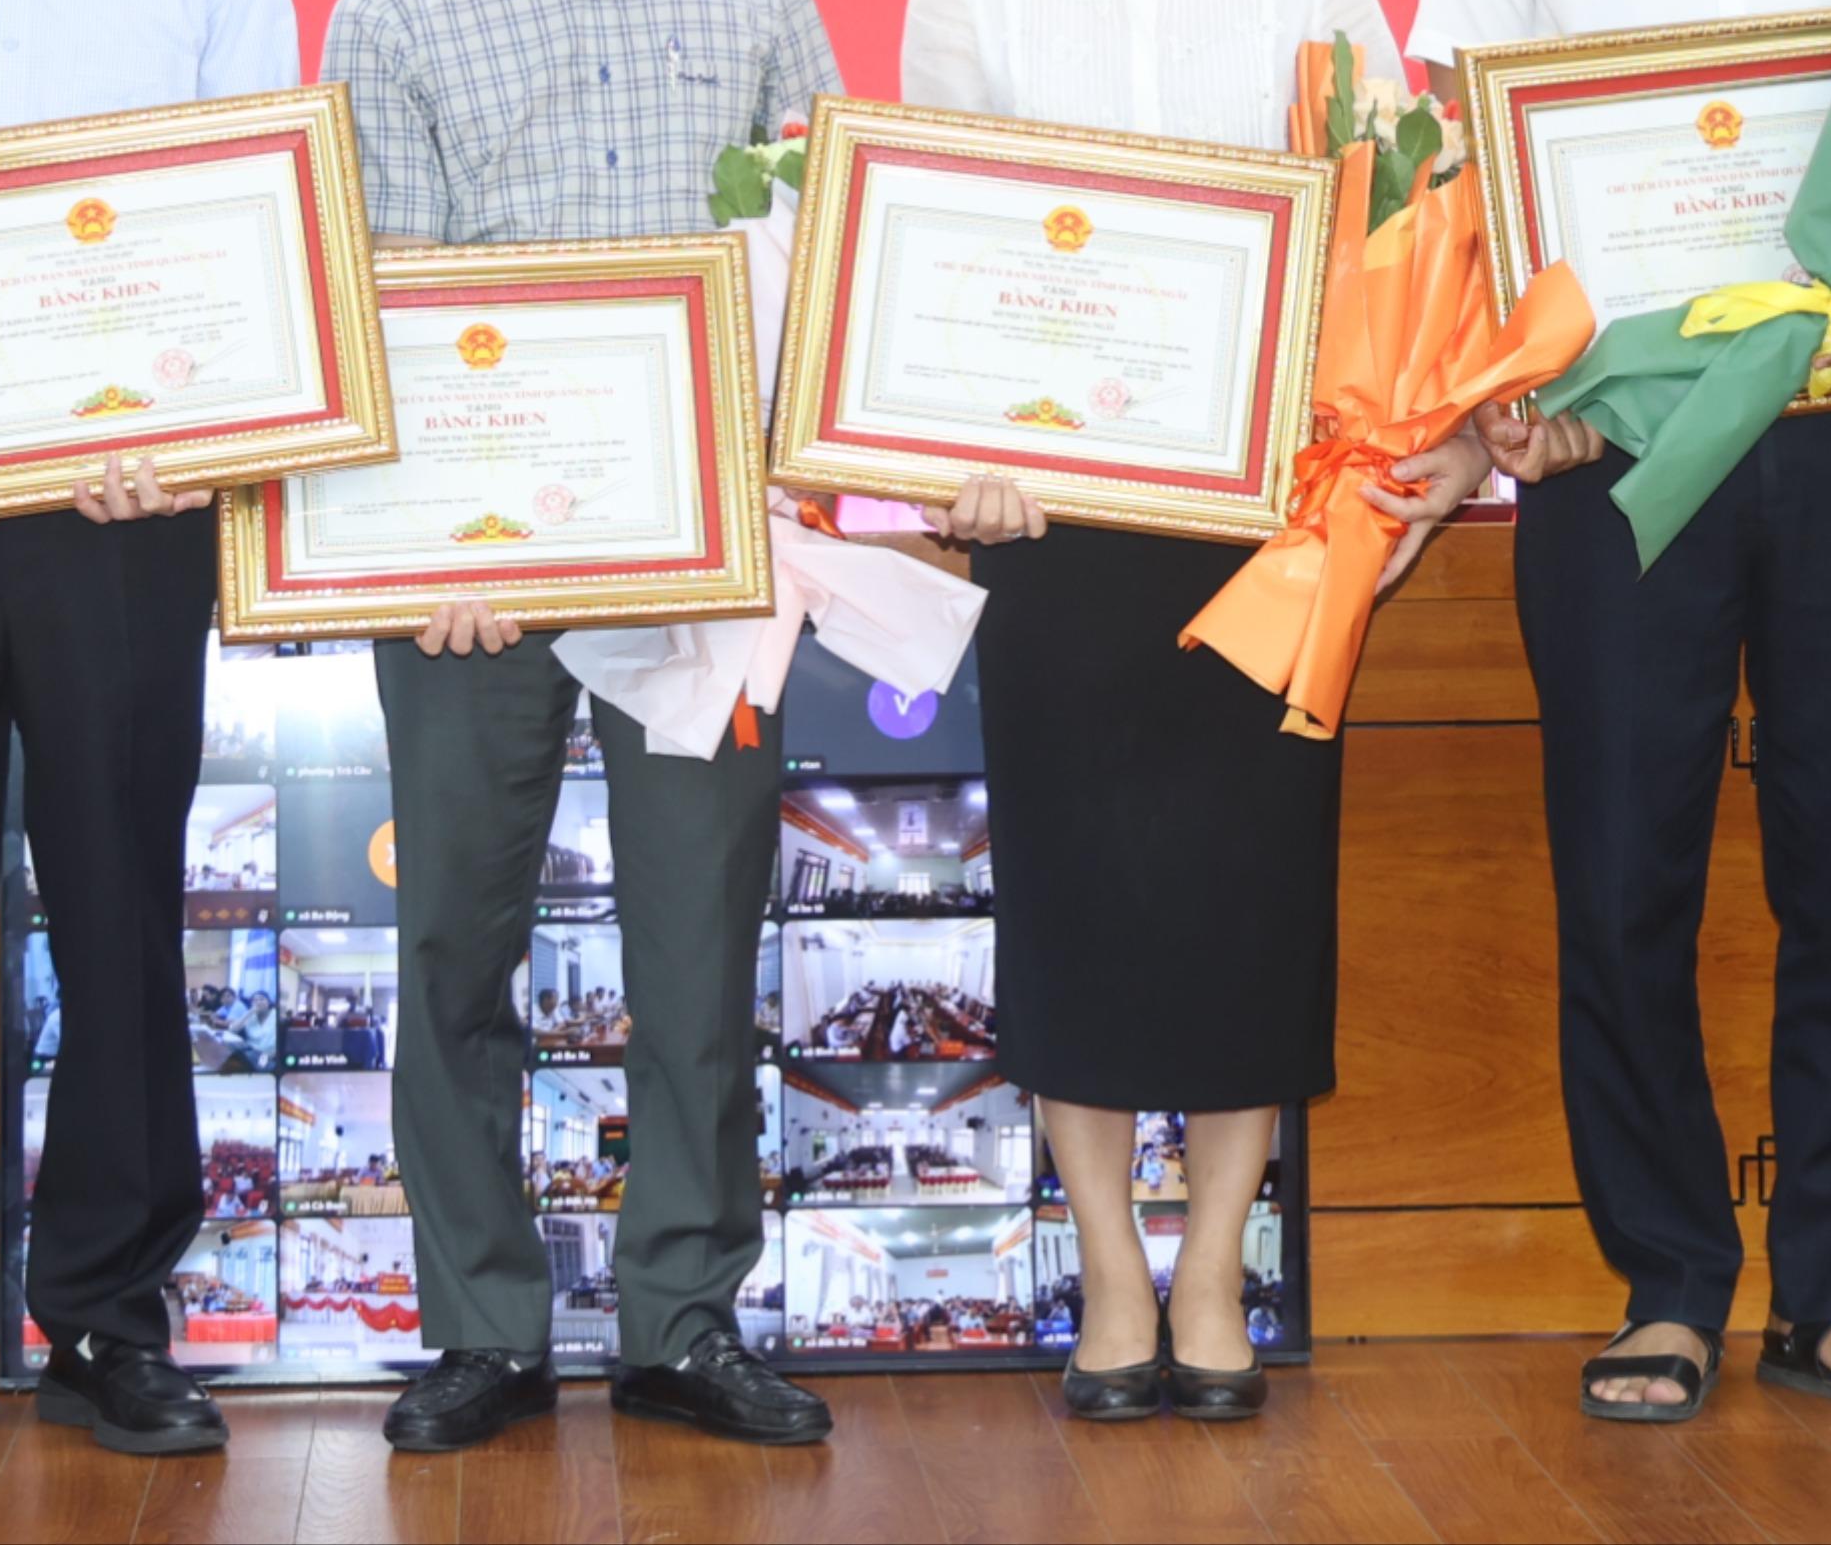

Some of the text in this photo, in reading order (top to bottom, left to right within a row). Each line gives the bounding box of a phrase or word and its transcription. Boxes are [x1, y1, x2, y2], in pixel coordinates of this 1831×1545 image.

[1673, 190, 1786, 216] BẰNG KHEN
[38, 280, 161, 310] BẰNG KHEN
[998, 286, 1118, 318] BẰNG KHEN
[425, 410, 547, 430] BẰNG KHEN
